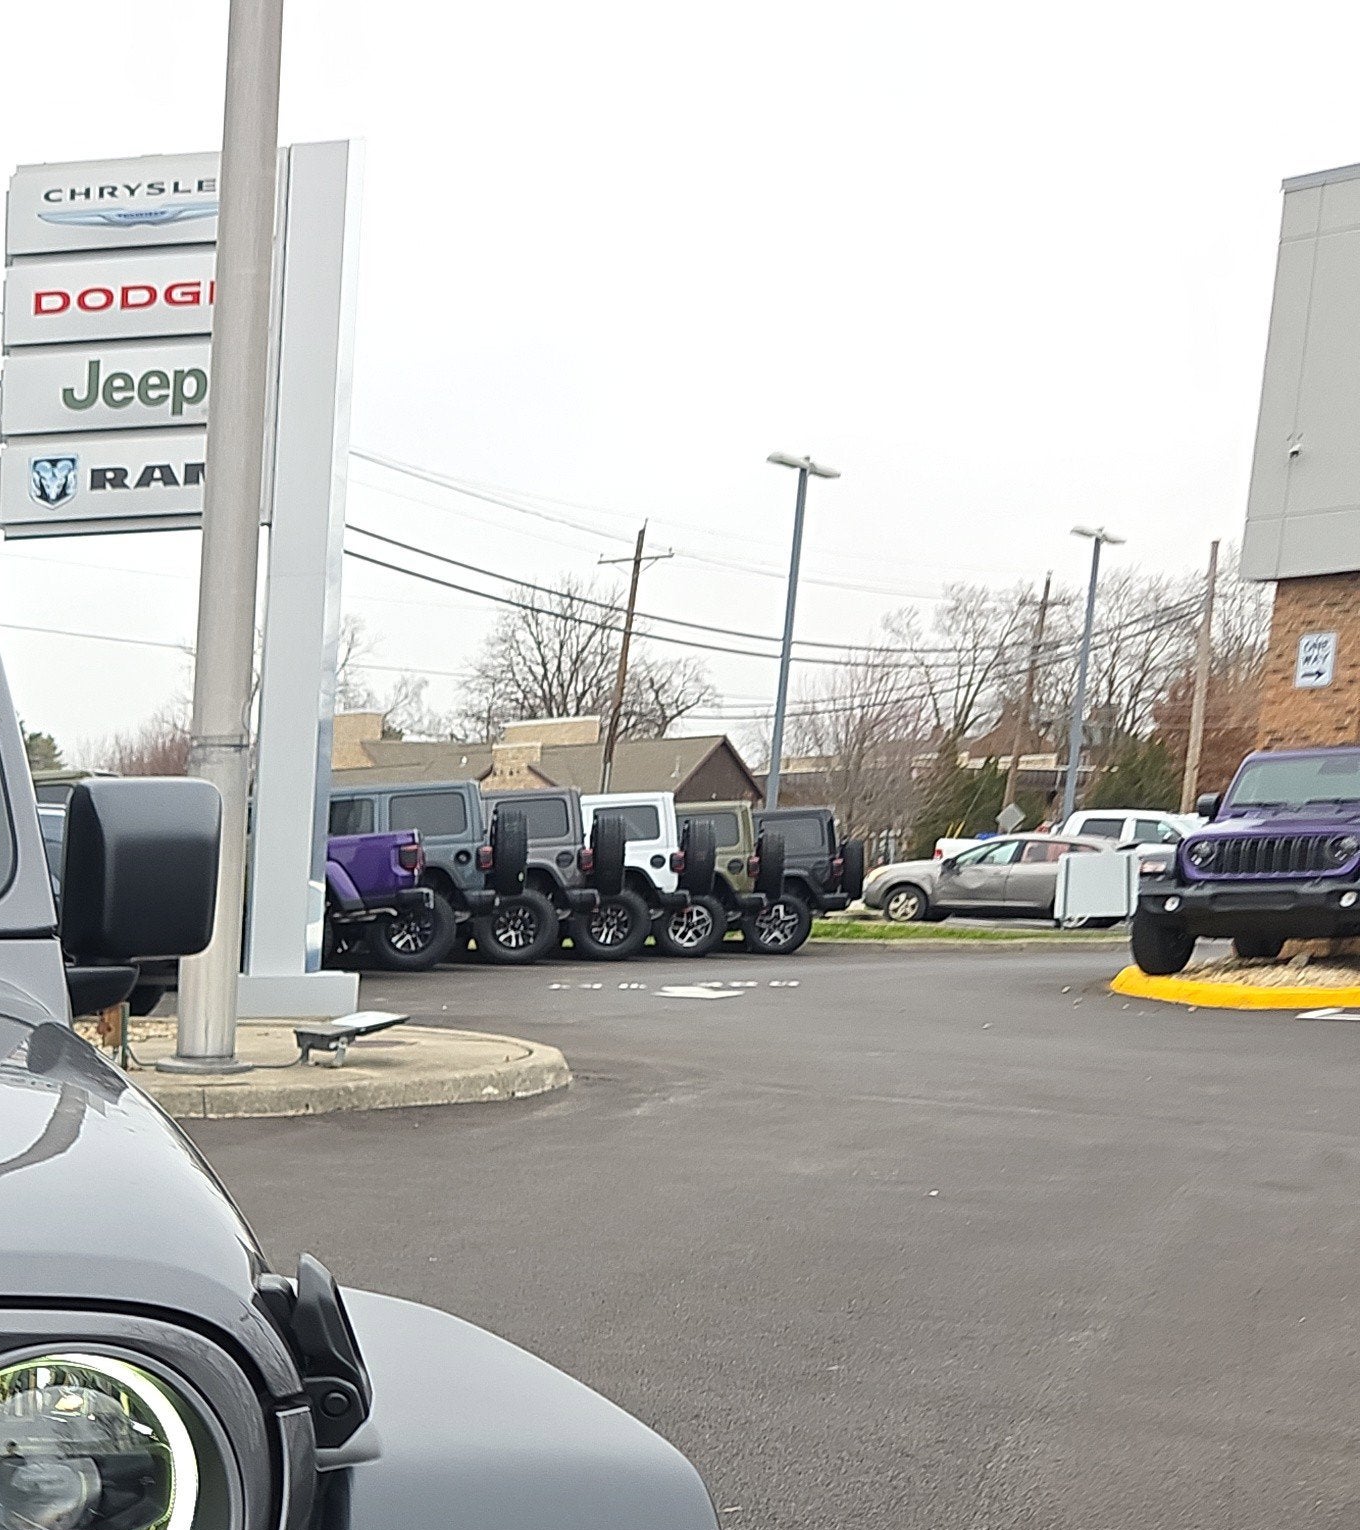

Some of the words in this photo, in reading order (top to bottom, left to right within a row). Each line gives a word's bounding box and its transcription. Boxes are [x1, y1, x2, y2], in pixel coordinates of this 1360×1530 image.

[43, 178, 217, 203] CHRYSLE
[34, 281, 215, 315] DODG
[62, 360, 208, 416] Jeep
